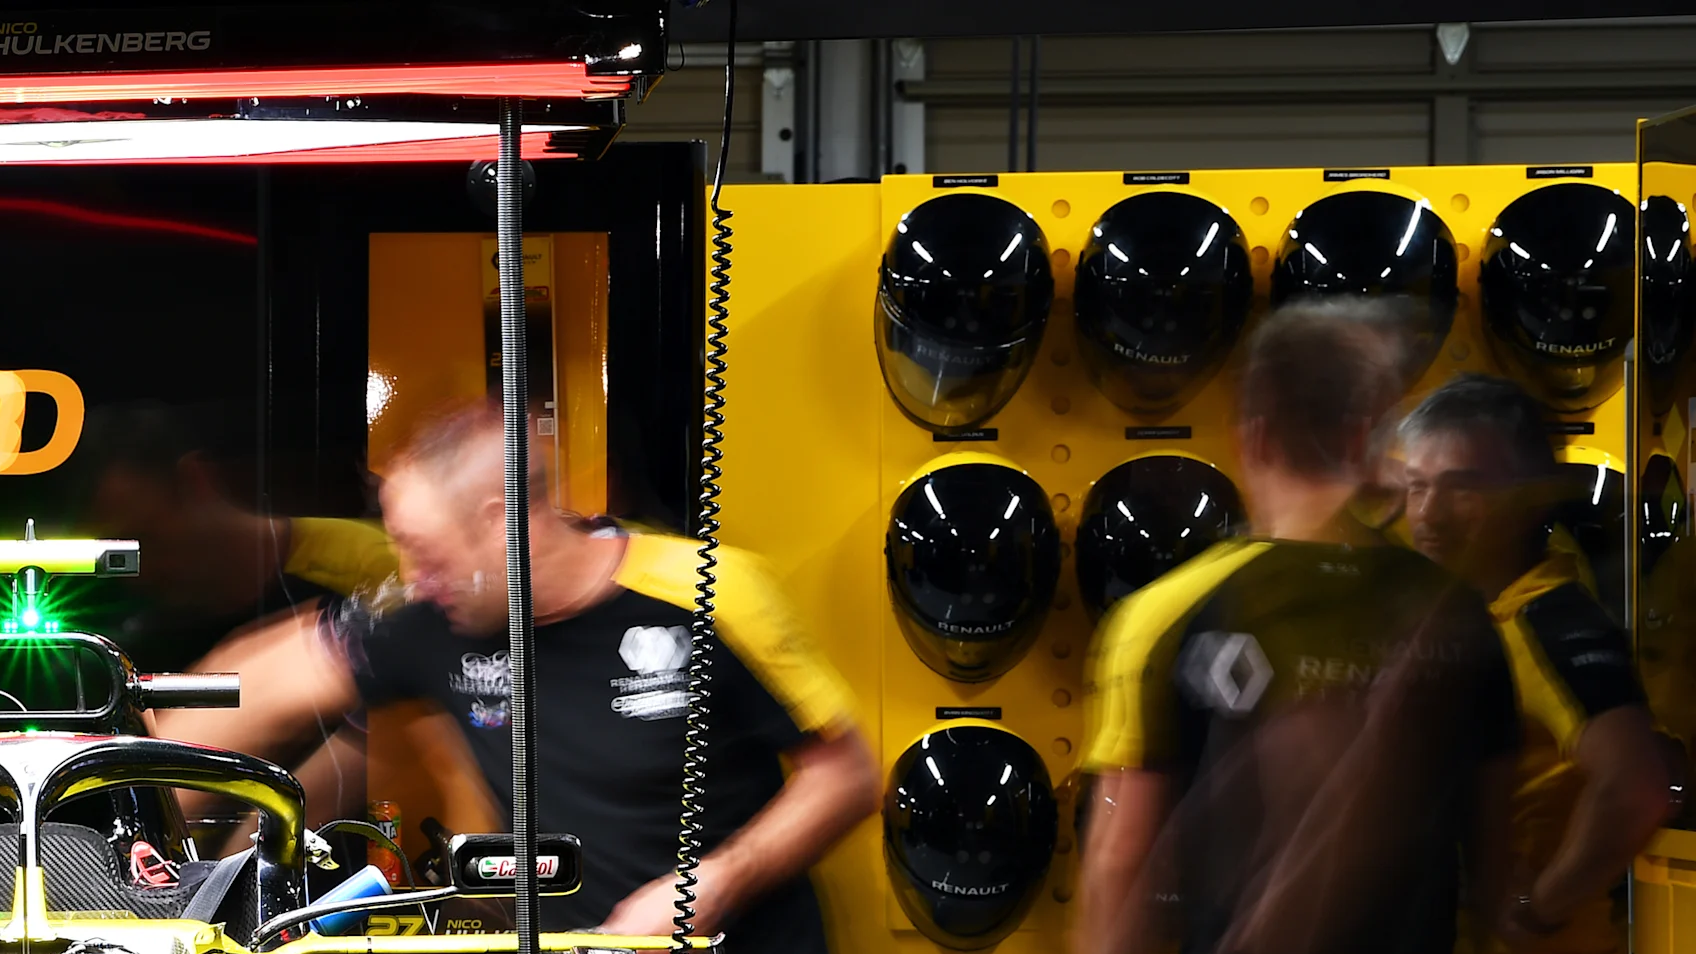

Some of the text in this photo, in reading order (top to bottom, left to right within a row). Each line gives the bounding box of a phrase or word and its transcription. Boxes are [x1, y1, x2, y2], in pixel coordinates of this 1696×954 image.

[1536, 338, 1616, 353] RENAULT
[1113, 343, 1190, 364] RENAULT
[938, 620, 1015, 634] RENAULT
[932, 880, 1009, 895] RENAULT
[447, 919, 482, 929] NICO
